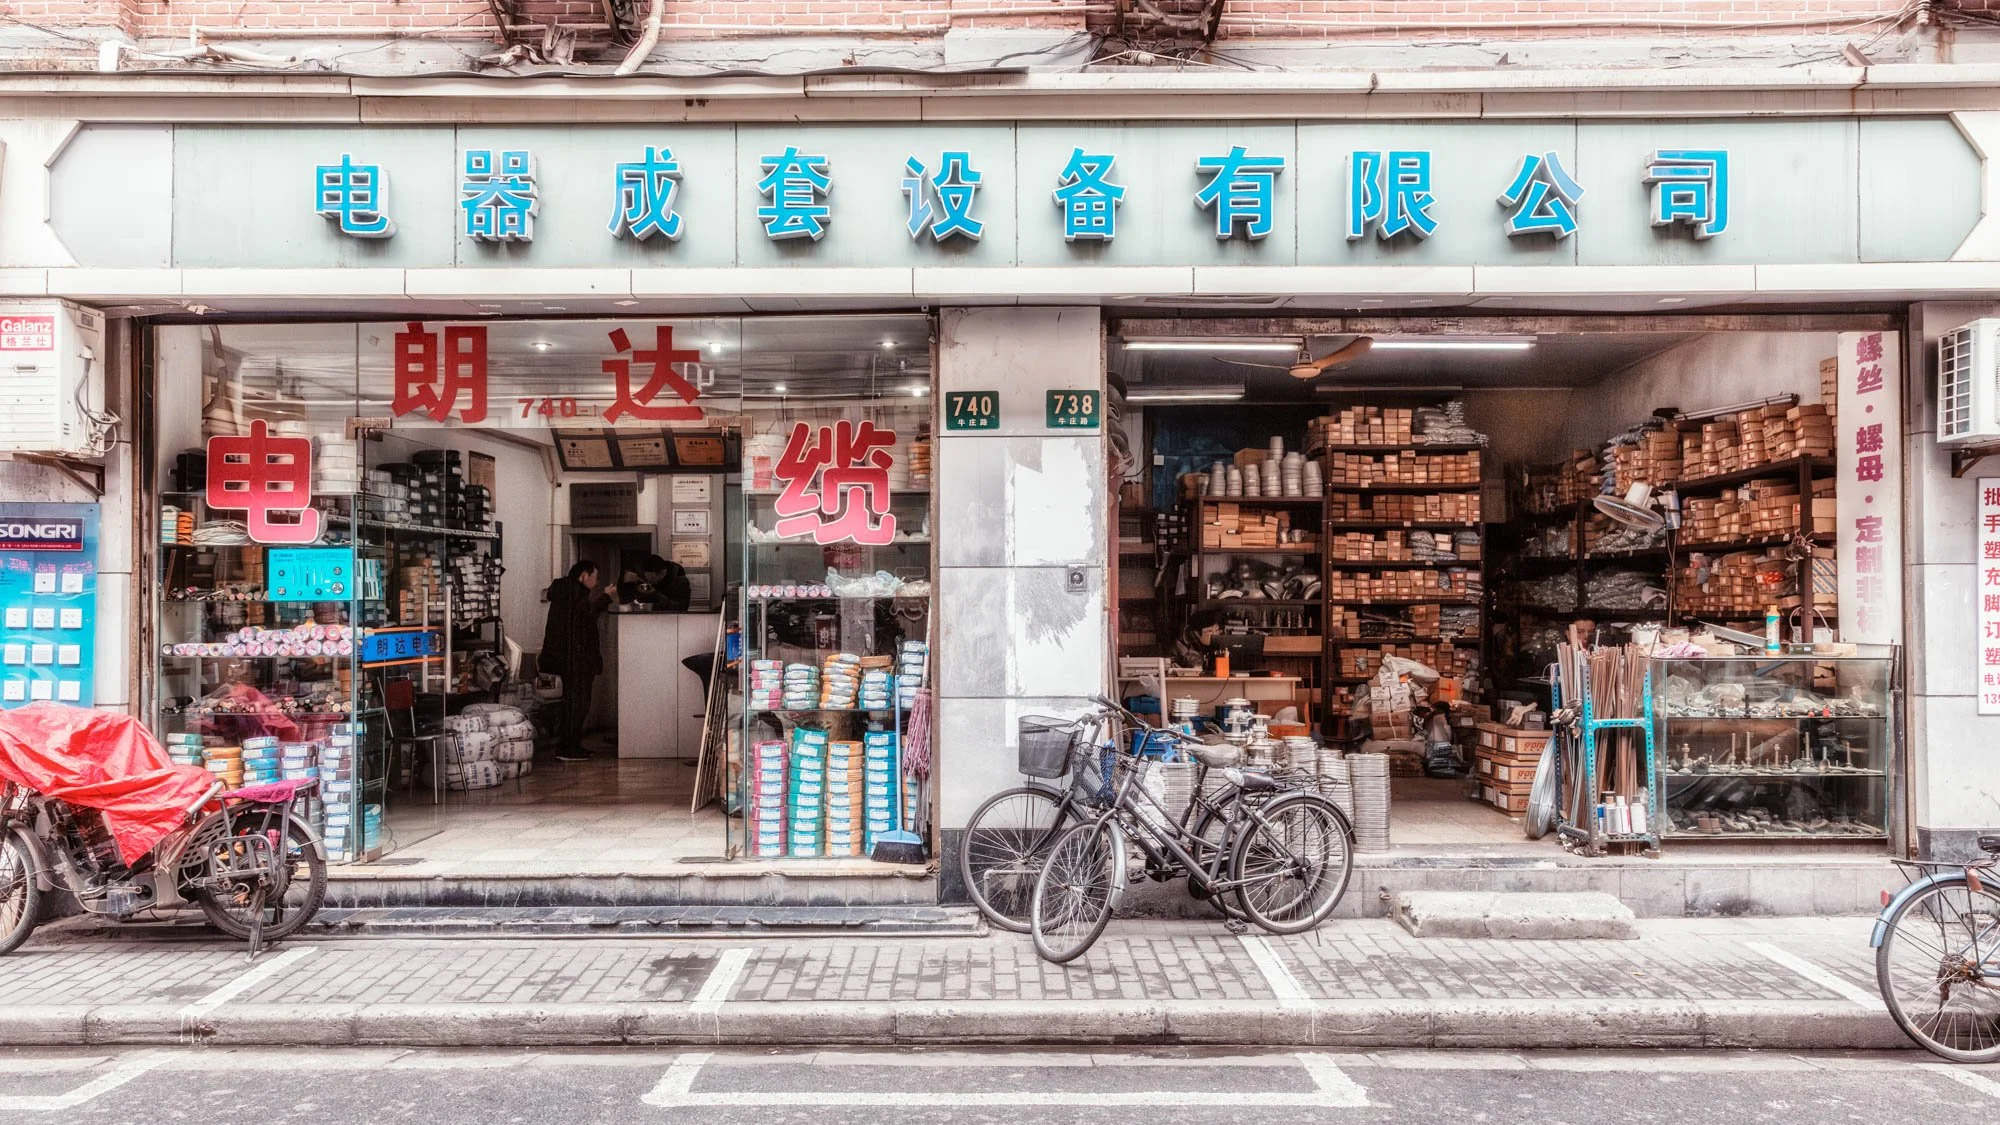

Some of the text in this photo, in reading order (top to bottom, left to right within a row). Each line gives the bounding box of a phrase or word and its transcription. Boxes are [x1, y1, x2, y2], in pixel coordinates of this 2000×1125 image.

[314, 145, 1730, 241] 电器成套设备有限公司
[1, 319, 52, 332] Galanz
[7, 336, 47, 347] 格兰仕
[517, 397, 577, 418] 740
[953, 396, 992, 416] 740
[1054, 395, 1093, 415] 738
[957, 418, 988, 427] 牛庄路
[1058, 416, 1089, 426] 牛庄路
